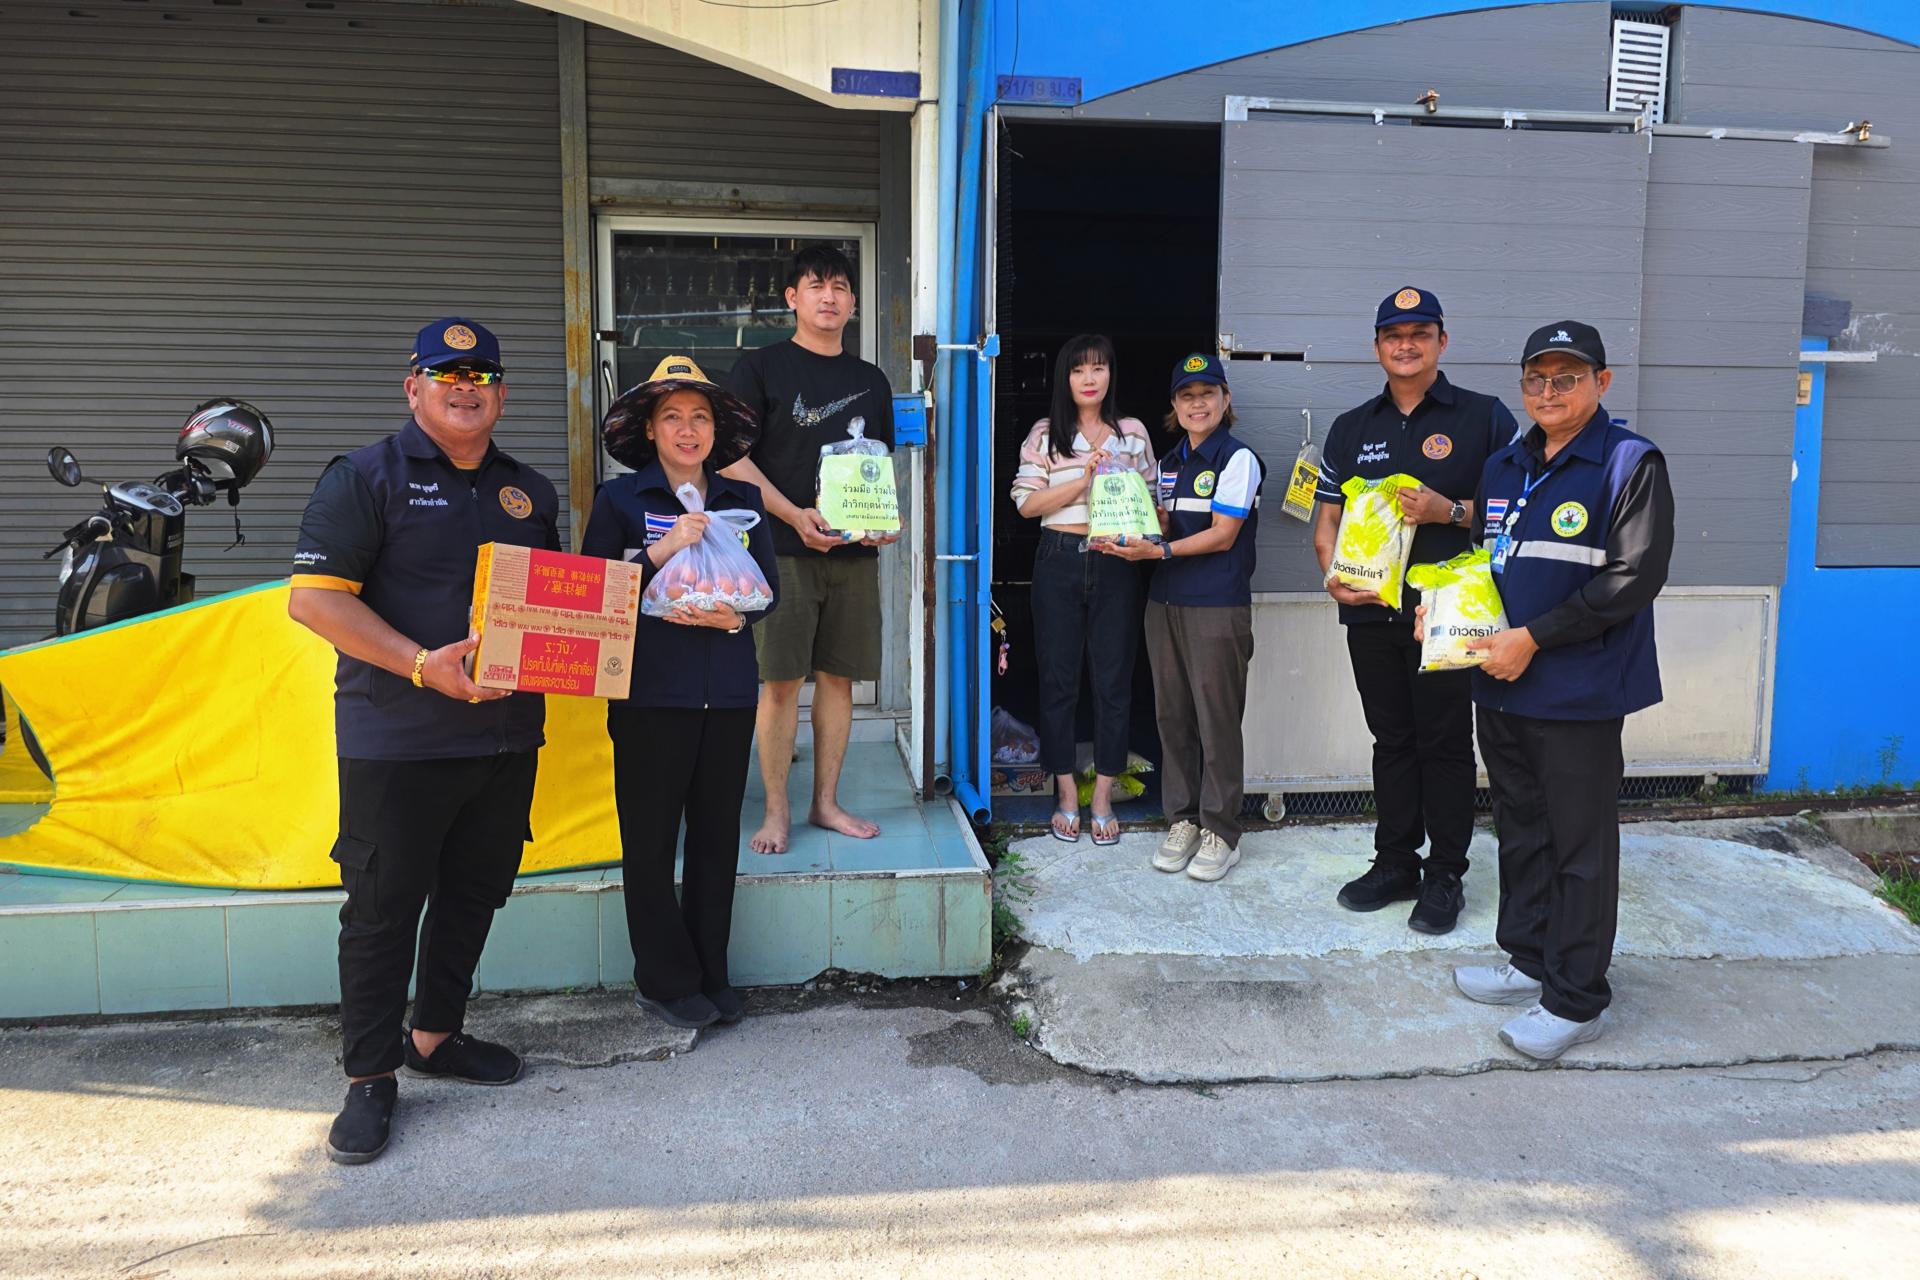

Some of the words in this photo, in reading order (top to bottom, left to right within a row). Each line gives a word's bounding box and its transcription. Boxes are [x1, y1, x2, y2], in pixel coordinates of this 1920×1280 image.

[842, 483, 871, 494] ร่วมมือ
[1333, 559, 1384, 580] ข้าวตราไก่แจ้
